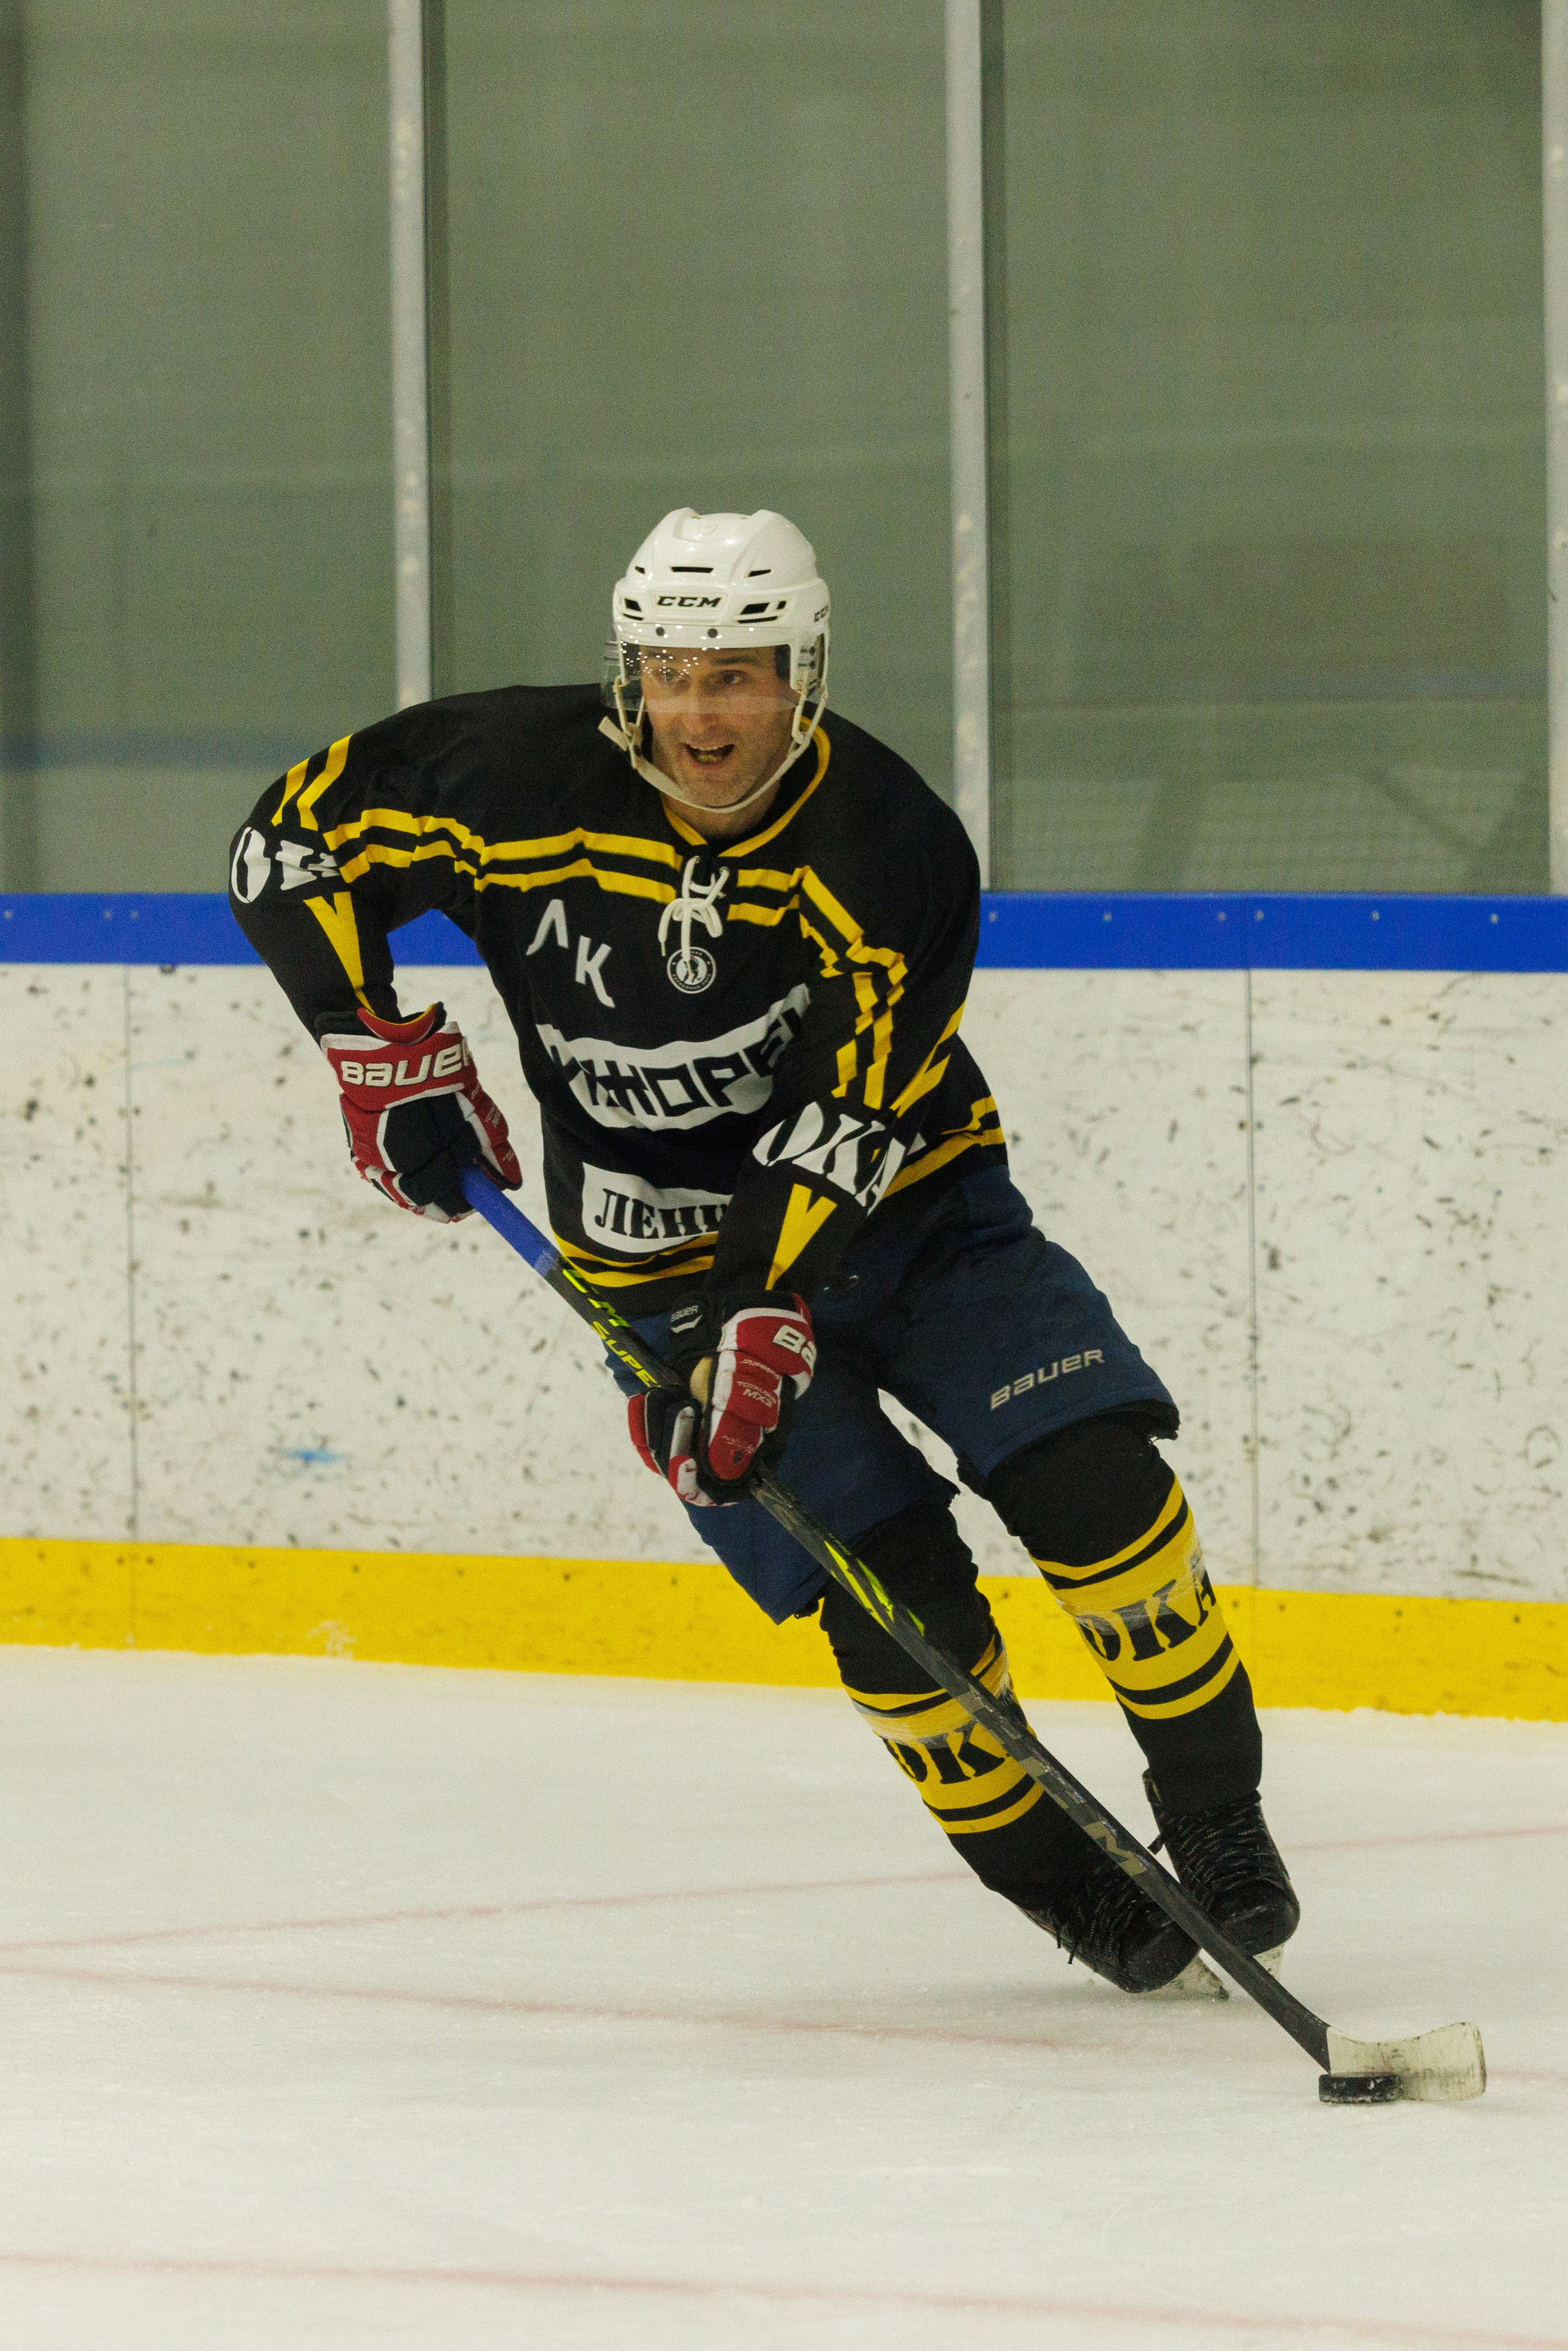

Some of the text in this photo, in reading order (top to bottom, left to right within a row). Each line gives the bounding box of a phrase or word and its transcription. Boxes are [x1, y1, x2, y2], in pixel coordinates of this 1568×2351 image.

[657, 596, 722, 608] CCM
[589, 1321, 662, 1388] SUPE
[990, 1348, 1105, 1410] BAUER
